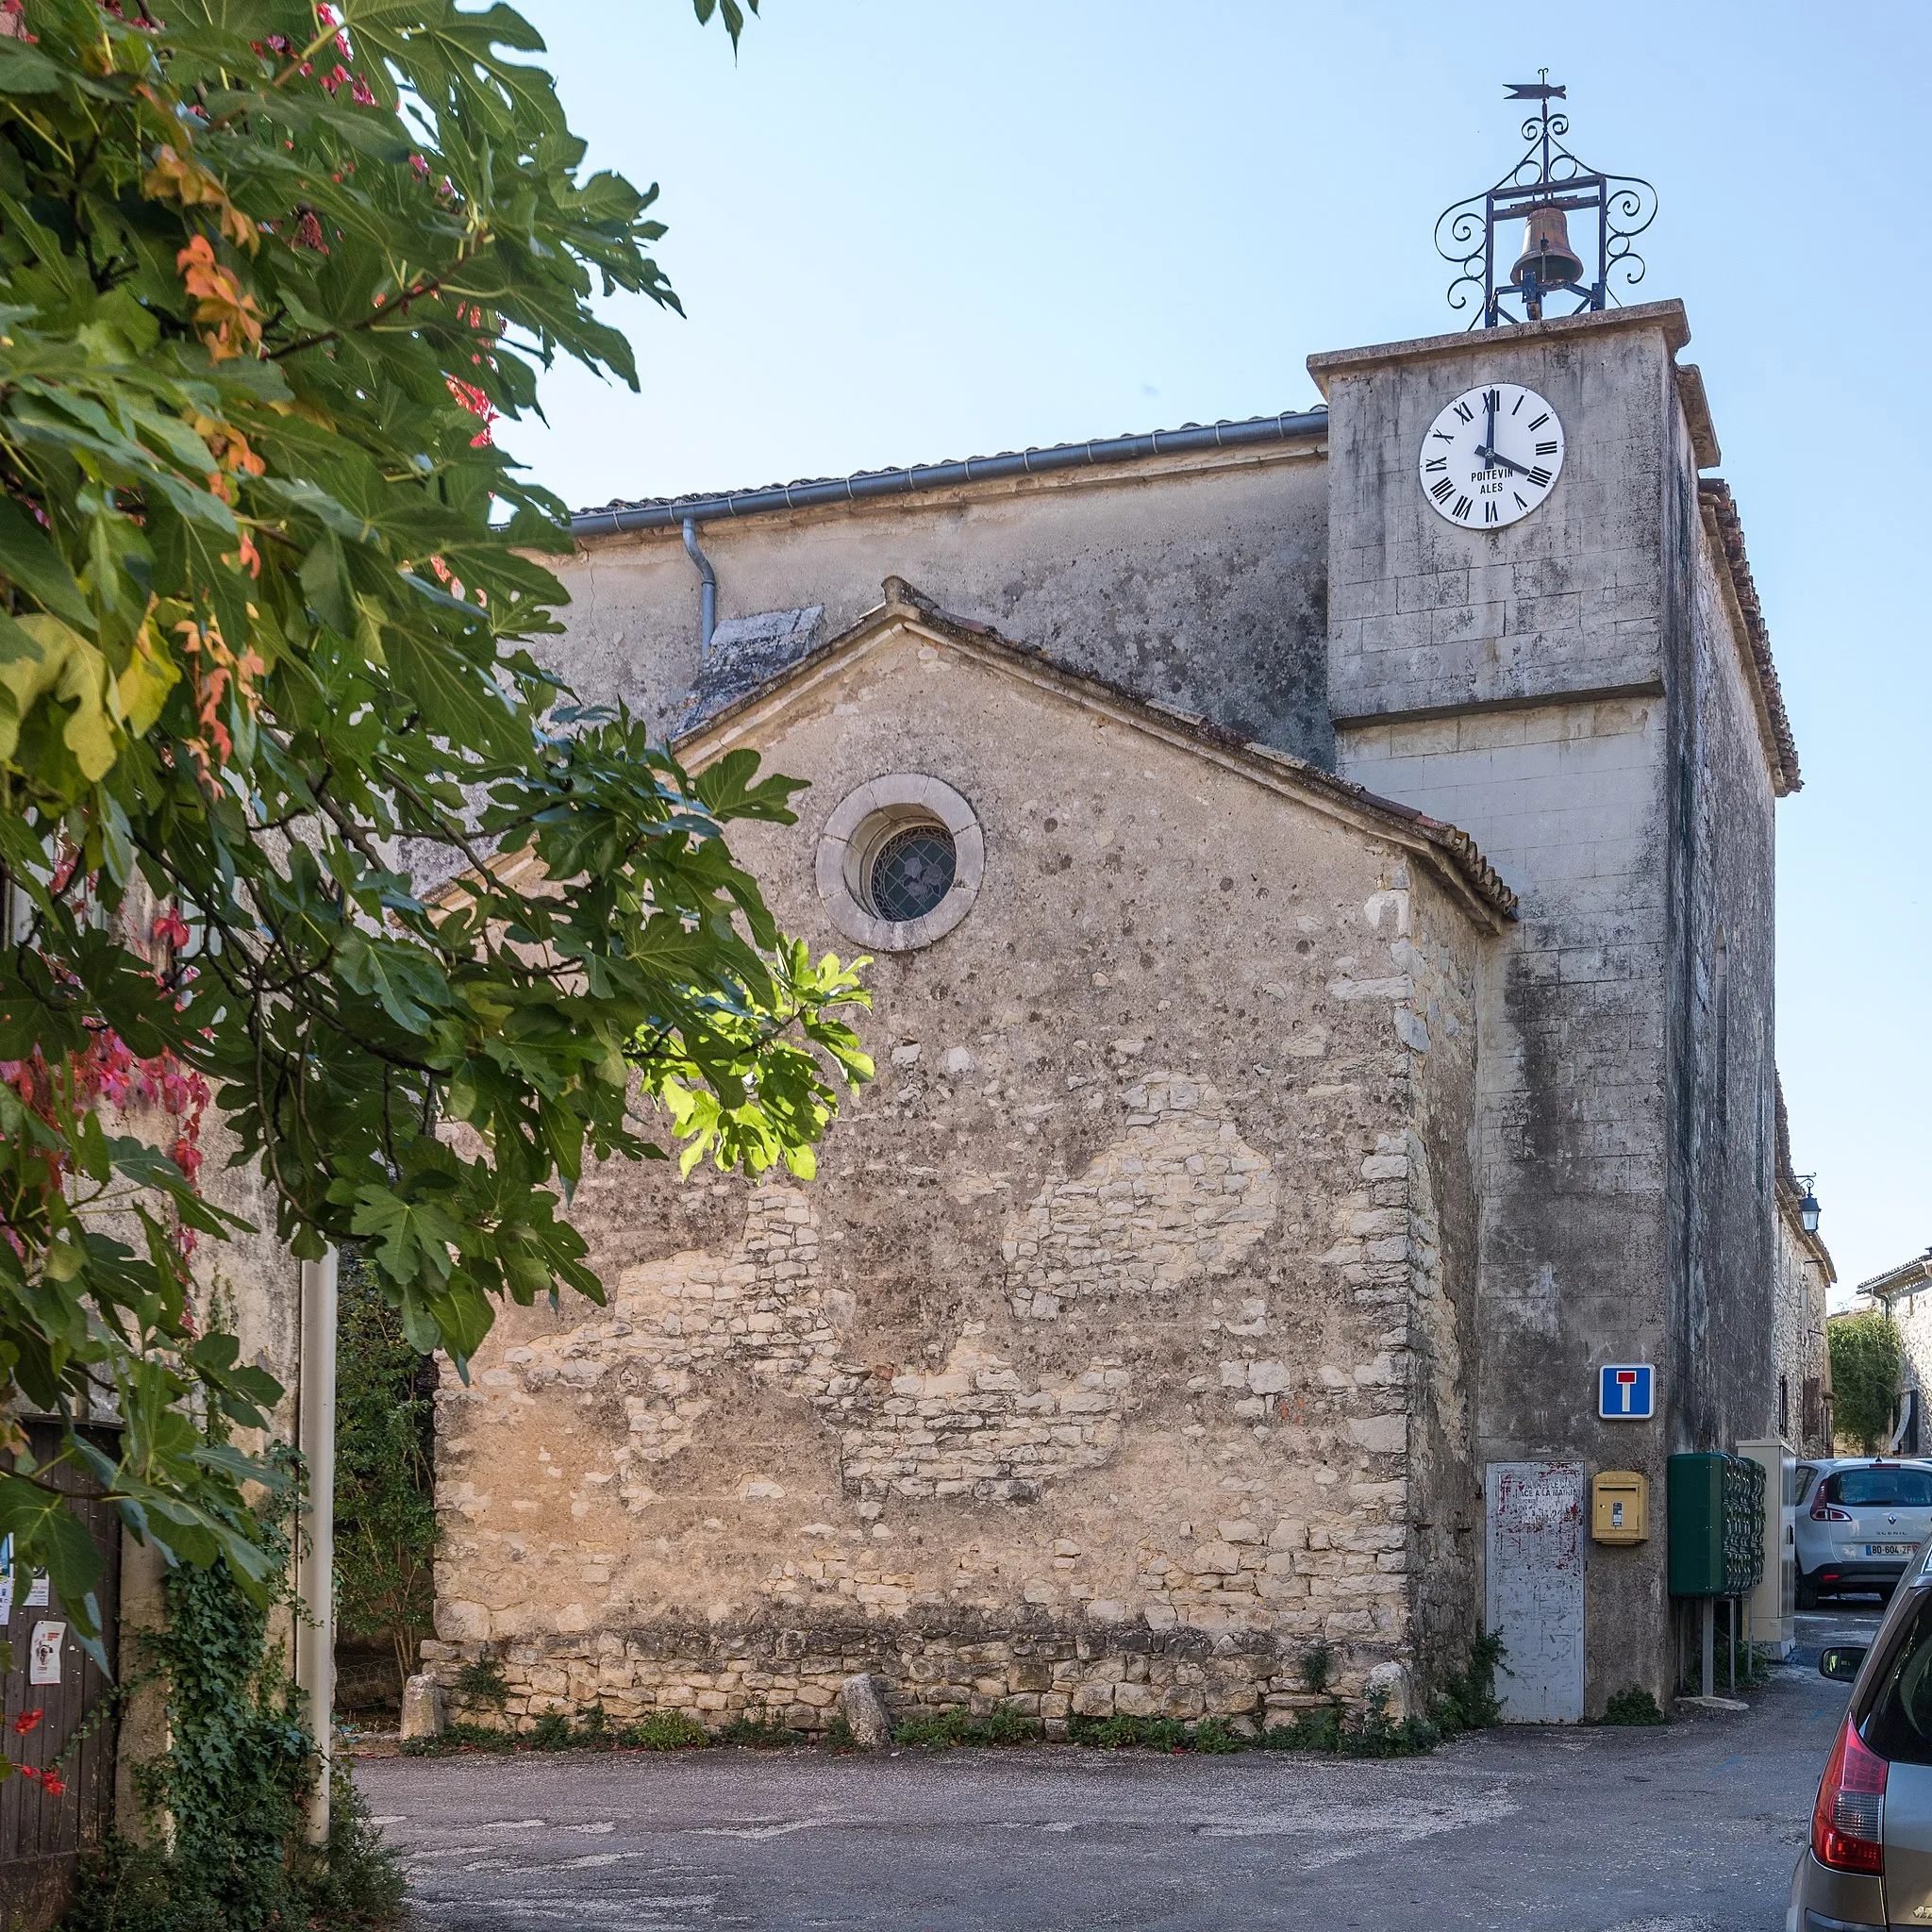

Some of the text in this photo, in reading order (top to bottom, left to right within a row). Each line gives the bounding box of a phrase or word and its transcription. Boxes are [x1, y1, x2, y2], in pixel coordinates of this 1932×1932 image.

[1453, 401, 1474, 425] XI
[1527, 412, 1550, 432] II
[1432, 428, 1455, 444] X
[1535, 441, 1557, 456] III
[1425, 456, 1447, 473] IX
[1471, 469, 1513, 482] POITEVIN
[1429, 476, 1457, 506] VIII
[1480, 483, 1504, 494] ALES
[1451, 494, 1474, 521] VII
[1512, 491, 1528, 511] V
[1485, 500, 1499, 523] VI
